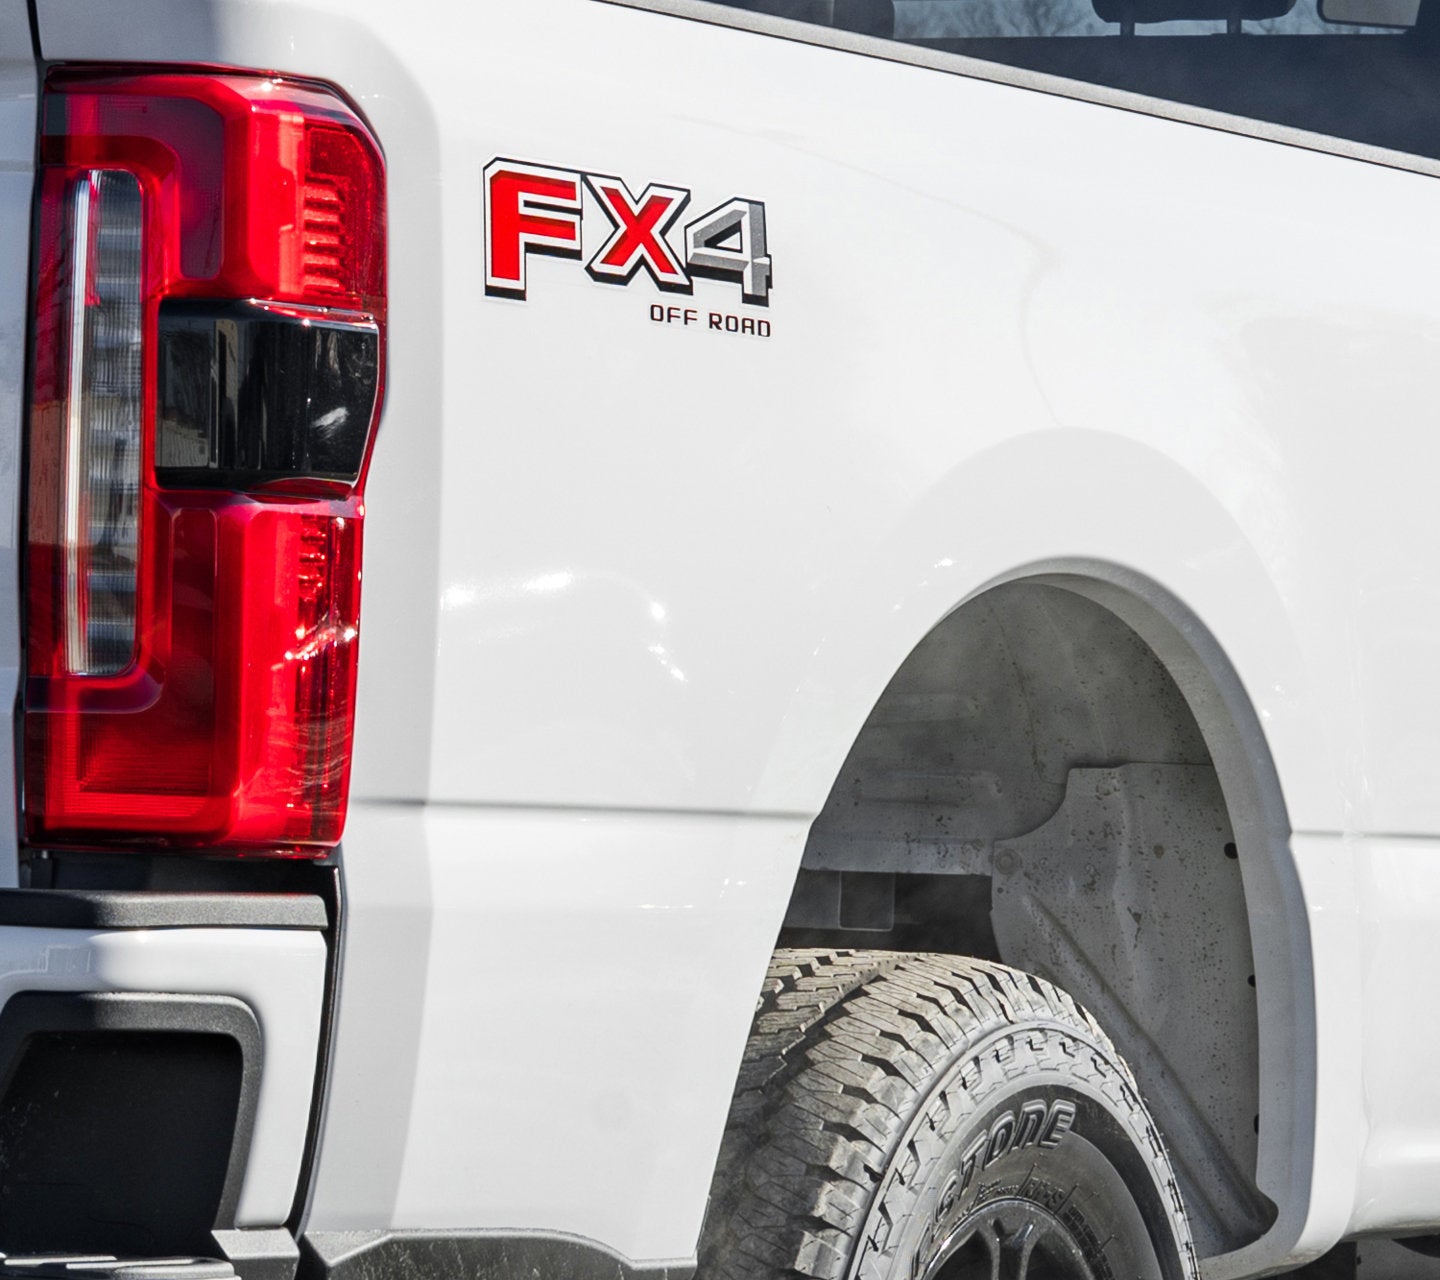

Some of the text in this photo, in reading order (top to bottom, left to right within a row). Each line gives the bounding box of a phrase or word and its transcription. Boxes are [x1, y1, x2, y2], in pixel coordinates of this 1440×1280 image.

[481, 155, 773, 308] FX4
[649, 303, 772, 338] OFF ROAD
